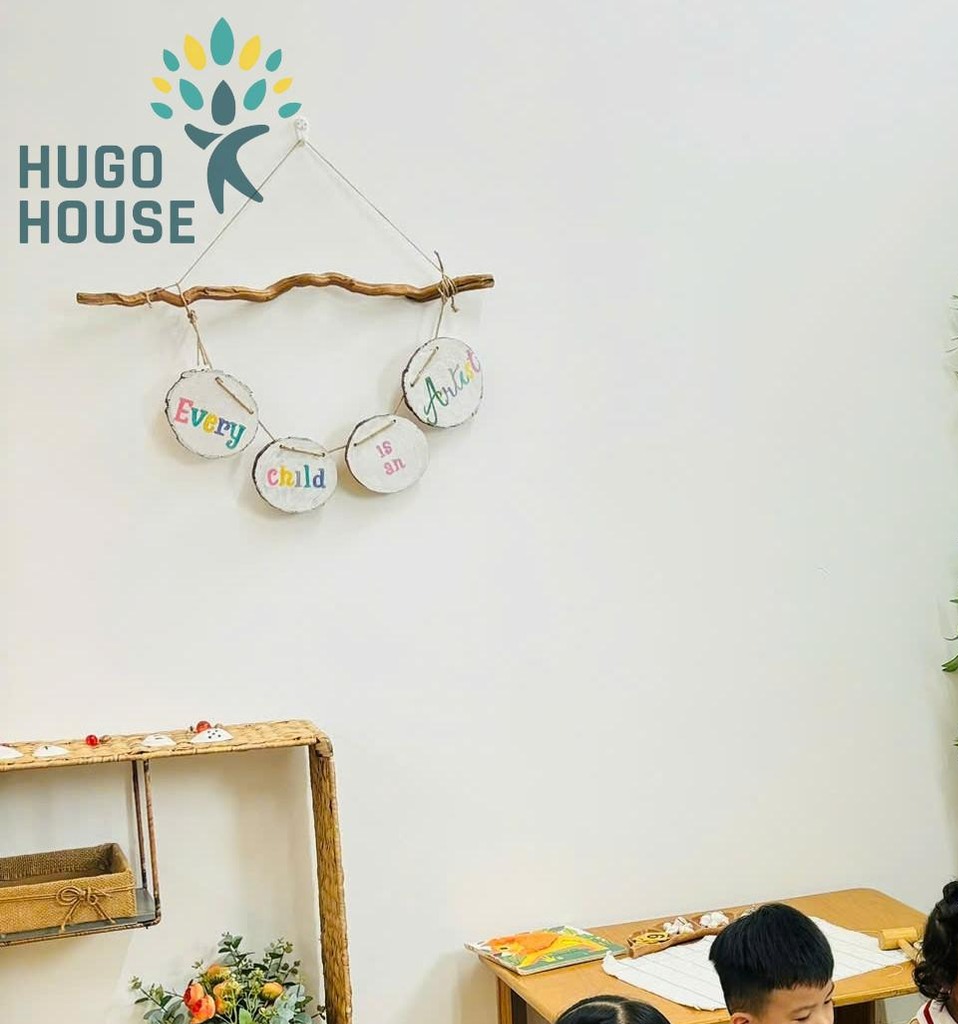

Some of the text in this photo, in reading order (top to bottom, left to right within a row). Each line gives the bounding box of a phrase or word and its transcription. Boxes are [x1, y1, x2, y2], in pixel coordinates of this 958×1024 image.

[423, 349, 482, 425] Artist
[173, 397, 247, 449] Every
[376, 441, 393, 458] is
[267, 465, 327, 489] child
[383, 458, 406, 476] an
